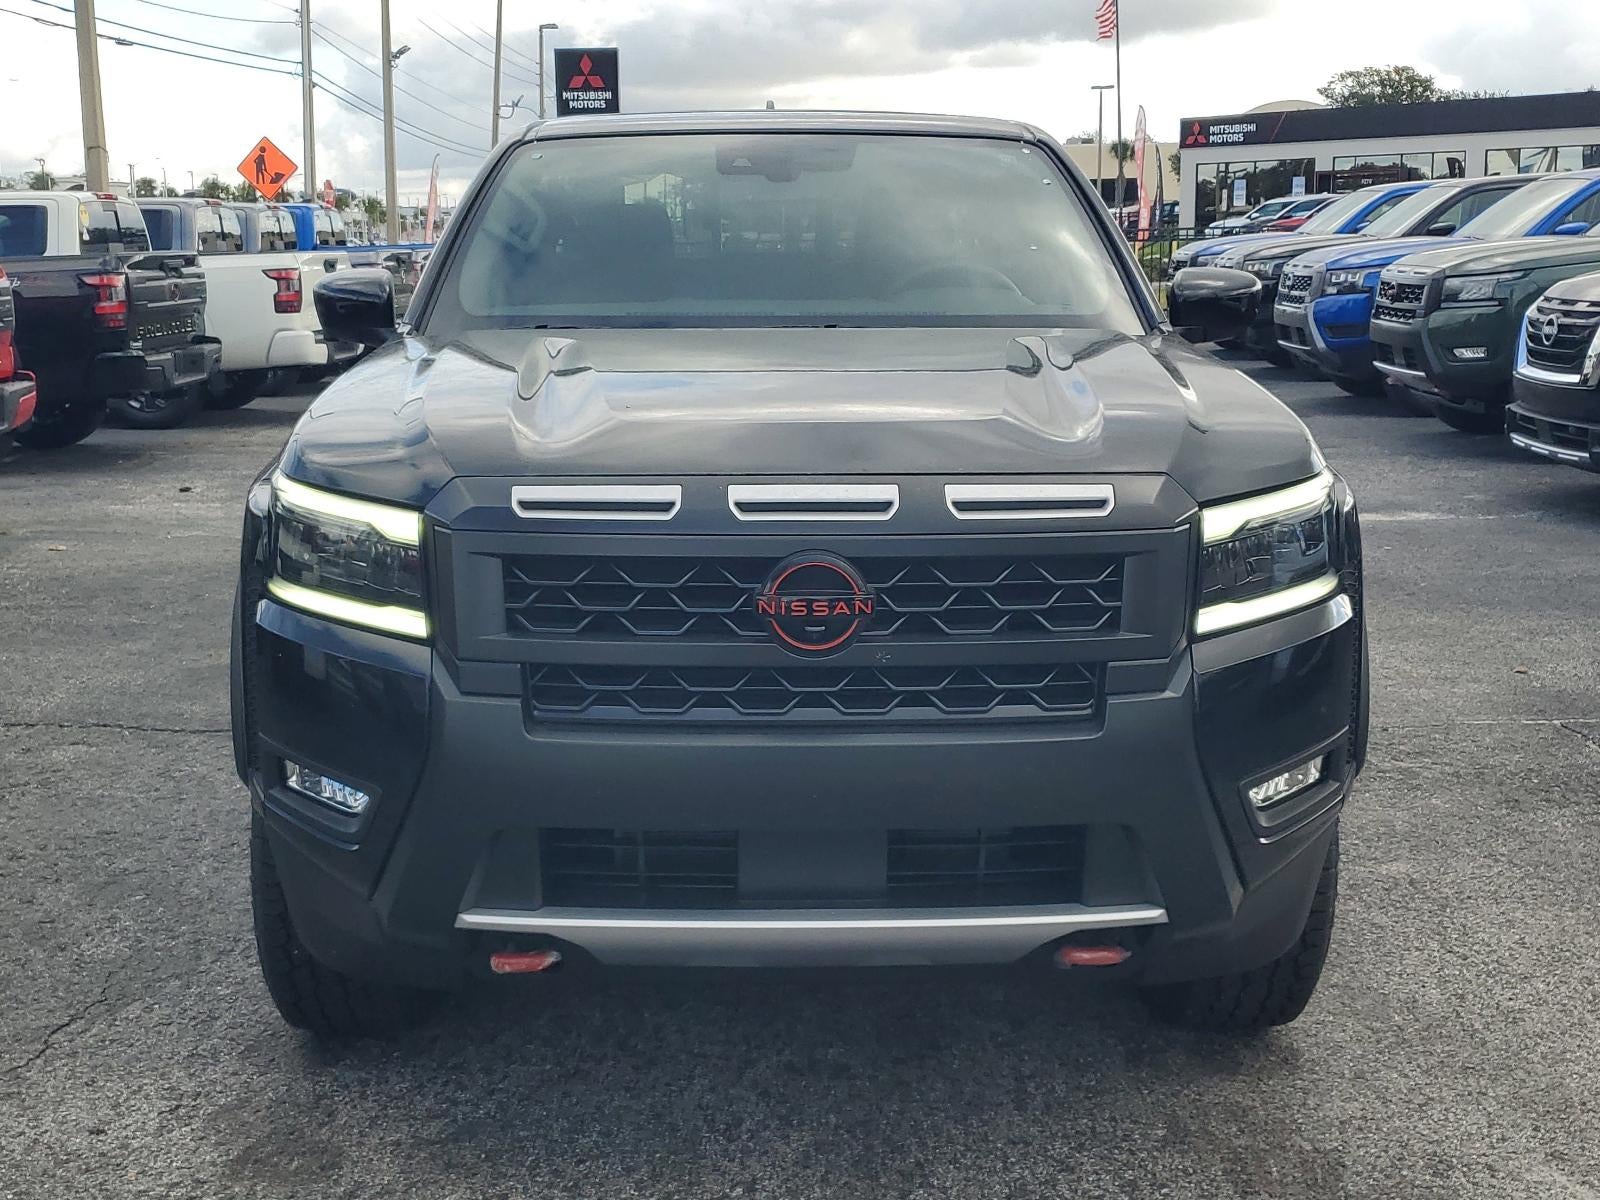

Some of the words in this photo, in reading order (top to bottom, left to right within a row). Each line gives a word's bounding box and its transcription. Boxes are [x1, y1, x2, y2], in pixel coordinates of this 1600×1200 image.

[562, 91, 612, 100] MITSUBISHI
[569, 100, 606, 109] MOTORS
[1209, 122, 1257, 134] MITSUBISHI
[1209, 133, 1244, 143] MOTORS
[758, 600, 872, 616] NISSAN
